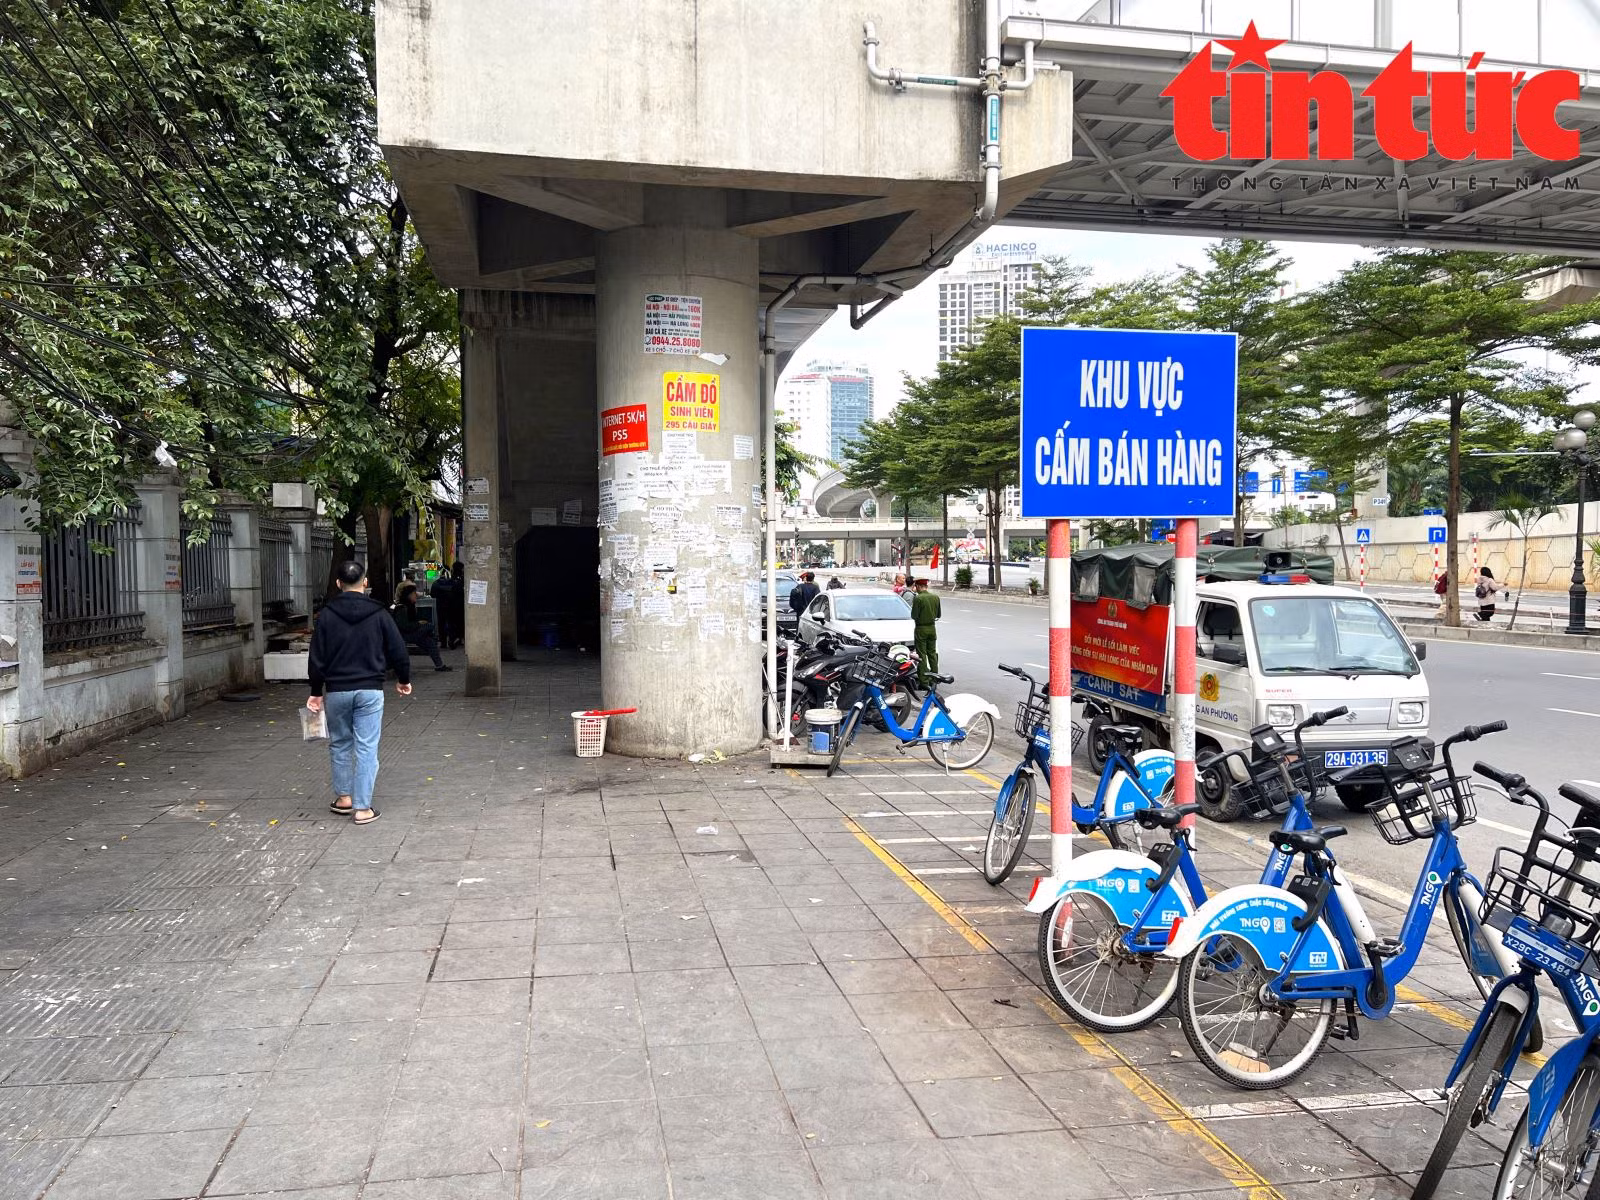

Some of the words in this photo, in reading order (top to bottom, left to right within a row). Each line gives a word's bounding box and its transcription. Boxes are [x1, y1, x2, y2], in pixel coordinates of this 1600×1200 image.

[986, 242, 1037, 252] HACINCO
[1080, 359, 1130, 409] KHU
[1138, 356, 1184, 416] VỰC
[626, 409, 645, 424] 5K/H
[670, 406, 692, 417] SINH
[694, 405, 713, 419] VIÊN
[666, 420, 680, 429] 295
[612, 429, 628, 441] PS5
[1035, 420, 1090, 486] CẤM
[1098, 430, 1148, 486] BÁN
[1157, 430, 1222, 486] HÀNG
[1201, 706, 1210, 715] AN
